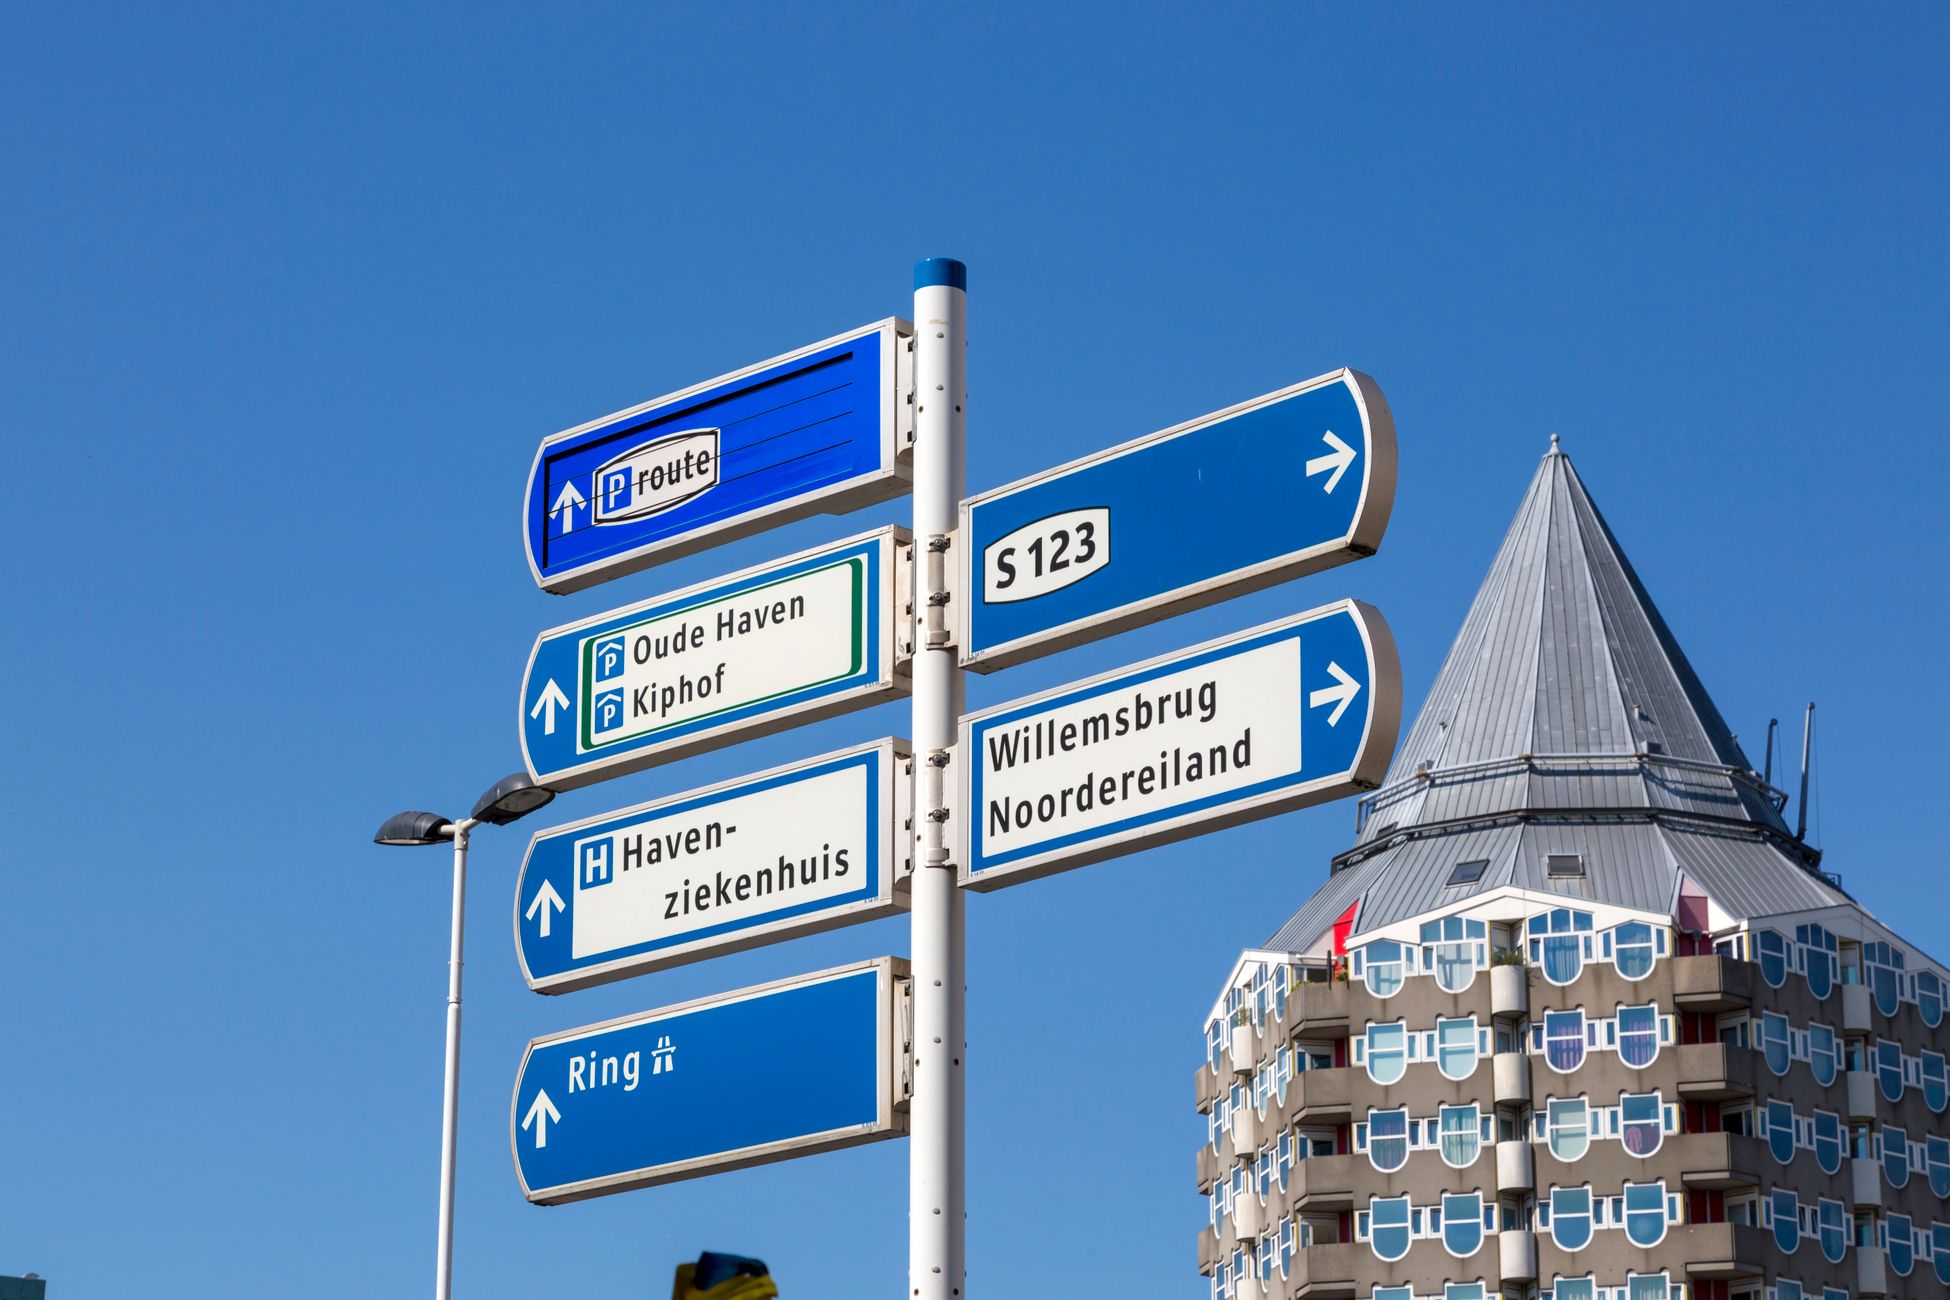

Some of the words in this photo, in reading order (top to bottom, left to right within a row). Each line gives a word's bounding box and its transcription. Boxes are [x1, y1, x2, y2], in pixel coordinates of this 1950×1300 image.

[607, 472, 625, 509] P
[637, 449, 711, 496] route
[995, 547, 1017, 590] S
[1027, 521, 1096, 578] 123
[633, 622, 705, 665] Oude
[716, 595, 804, 642] Haven
[633, 662, 726, 718] Kiphof
[988, 680, 1217, 773] Willemsbrug
[989, 727, 1251, 838] Noordereiland
[585, 843, 608, 884] H
[622, 822, 737, 872] Haven-
[664, 844, 849, 920] ziekenhuis
[568, 1050, 640, 1094] Ring
